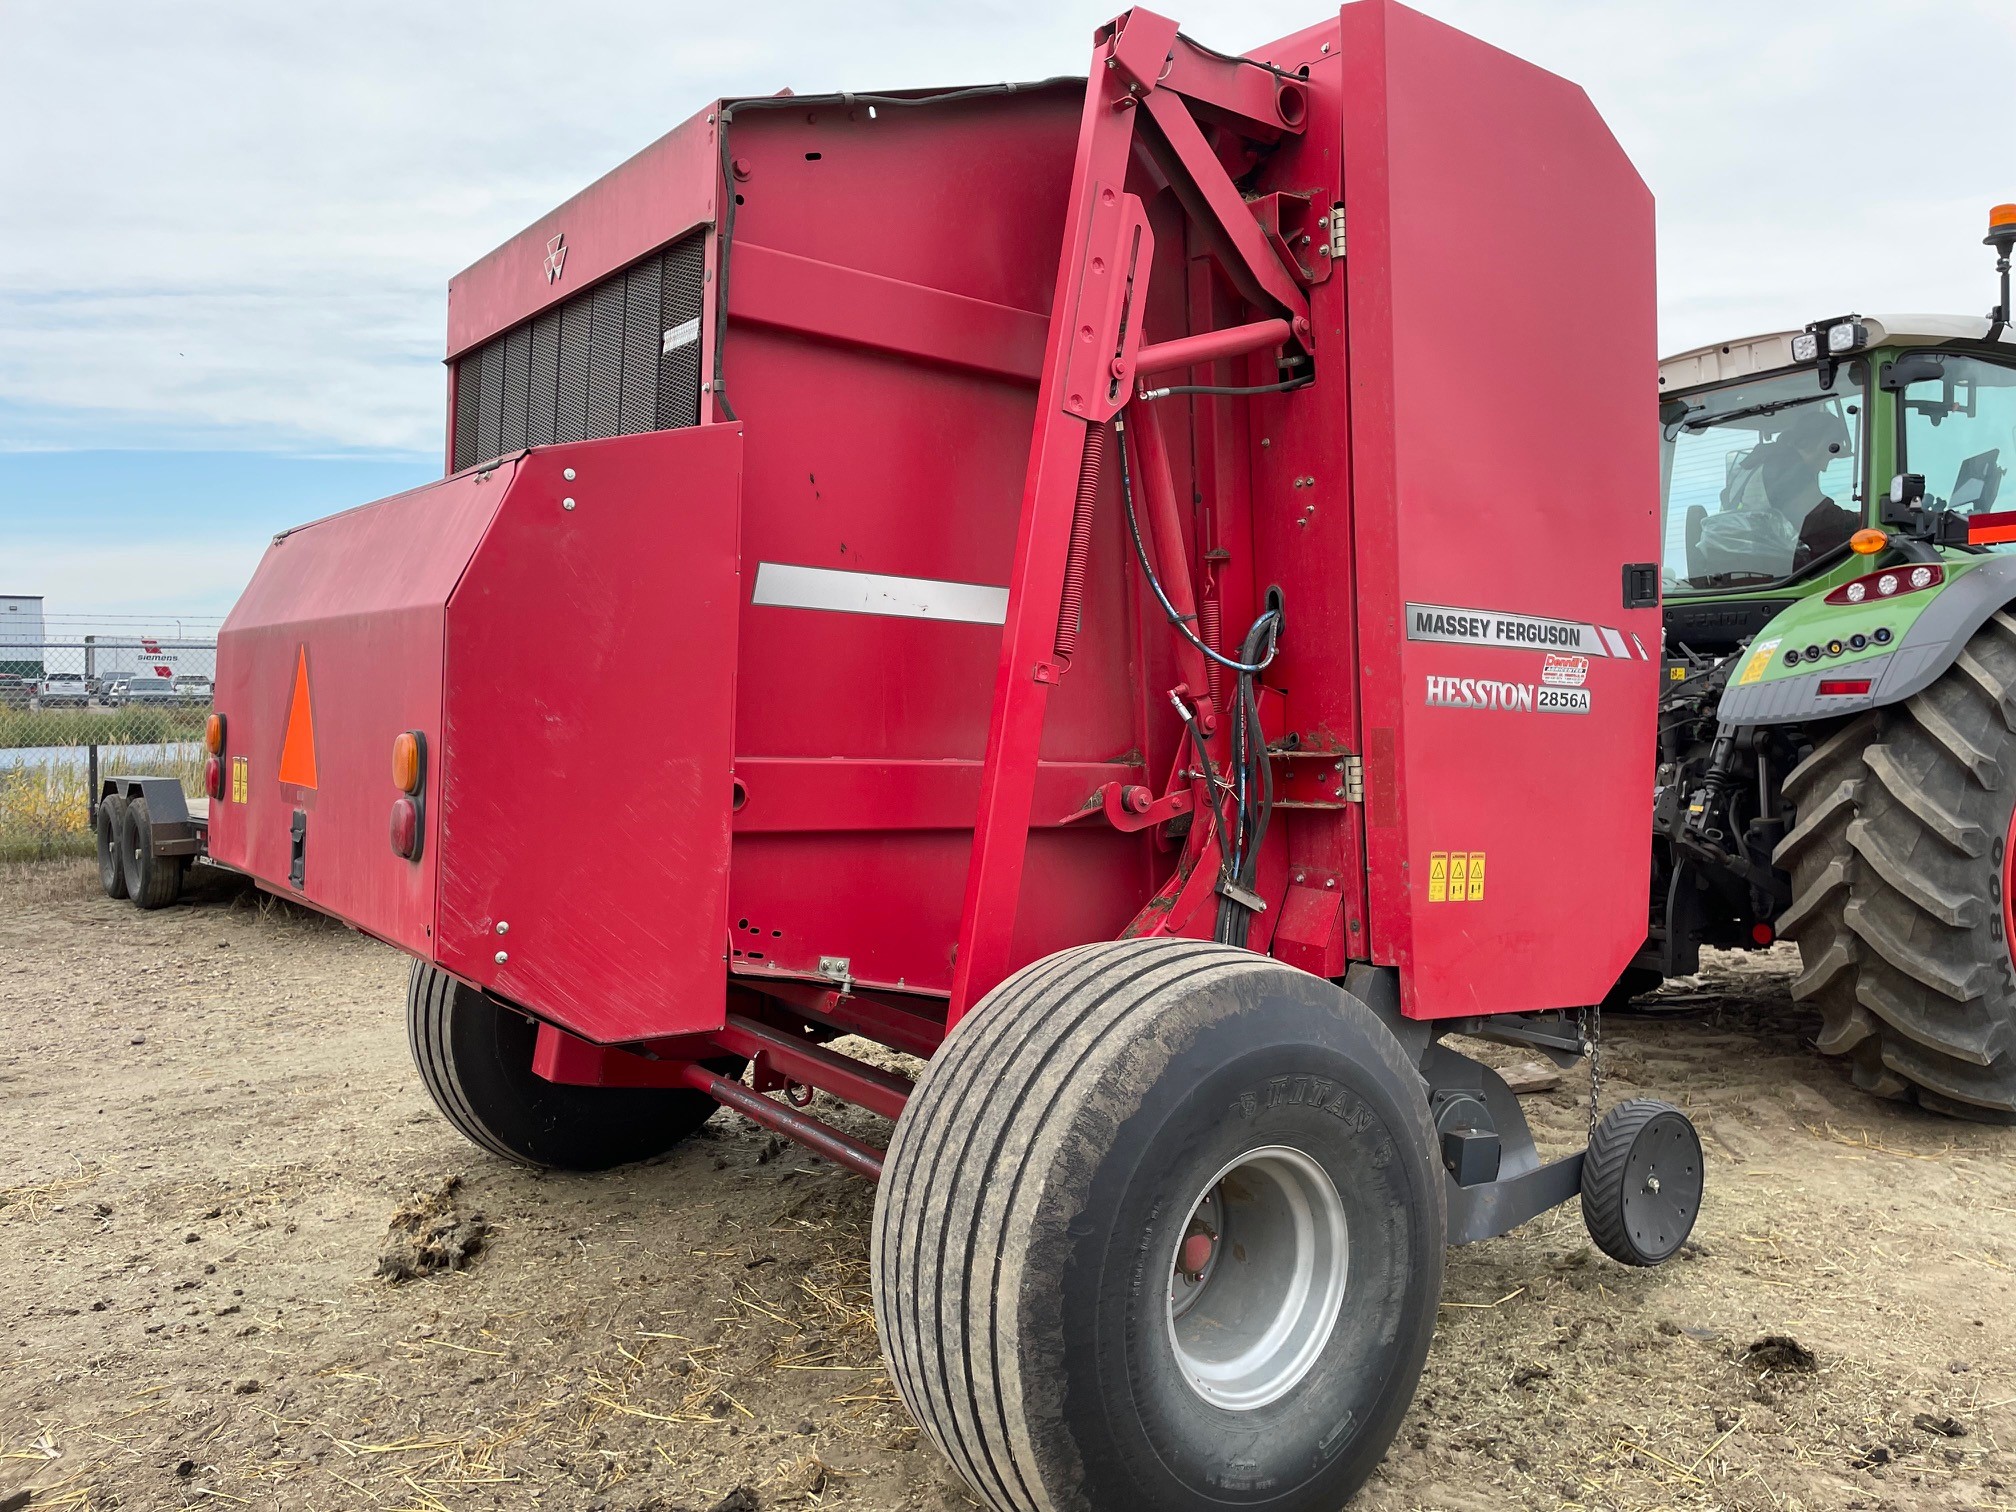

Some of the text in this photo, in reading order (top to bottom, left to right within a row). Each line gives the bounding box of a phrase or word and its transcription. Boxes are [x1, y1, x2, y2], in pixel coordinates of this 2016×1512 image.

[1417, 612, 1580, 646] MASSEY FERGUSON
[1685, 611, 1750, 627] FENDT
[1426, 676, 1588, 712] HESSTON 2856A
[1267, 1076, 1376, 1133] TITAN
